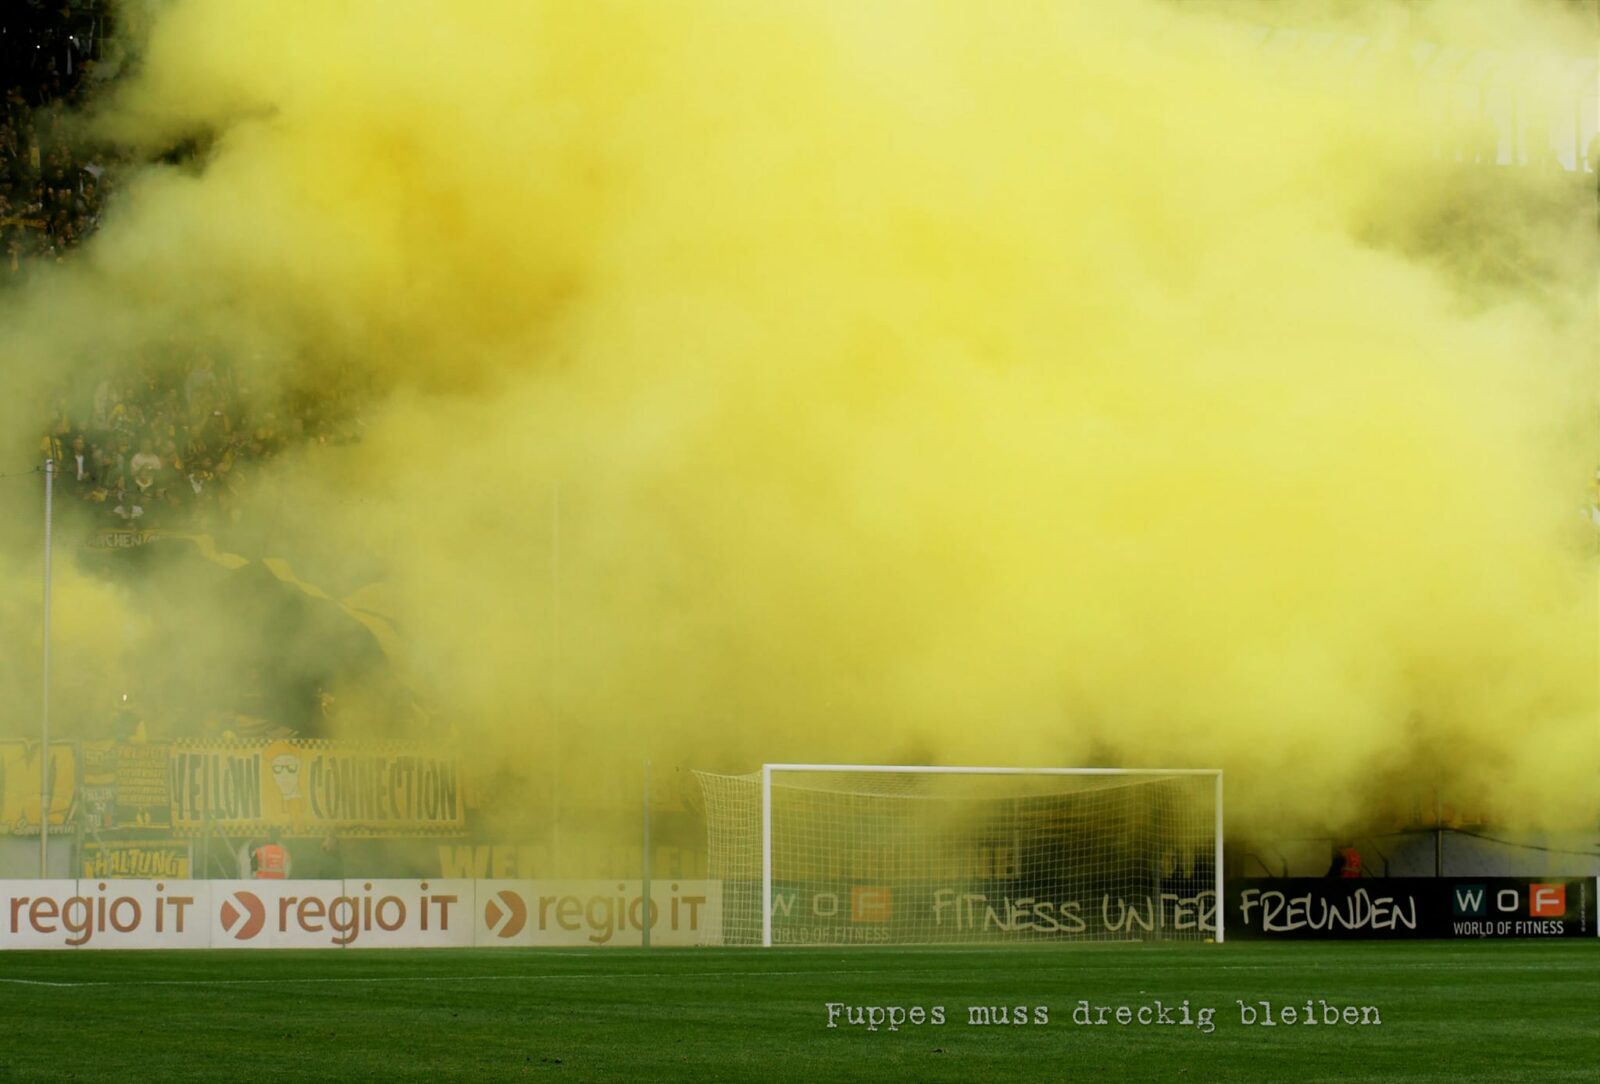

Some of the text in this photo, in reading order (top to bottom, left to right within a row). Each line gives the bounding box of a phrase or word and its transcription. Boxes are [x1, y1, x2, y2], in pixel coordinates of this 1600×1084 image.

[172, 753, 261, 821] YELLOW
[309, 754, 458, 821] CONNECTION
[95, 849, 177, 876] HALTUNG
[9, 883, 142, 945] regio
[278, 883, 407, 945] regio
[538, 882, 658, 944] regio
[771, 925, 891, 943] ORLD OF FITNESS
[932, 887, 1417, 933] FITNESS UNTER FREUNDEN
[1453, 920, 1564, 935] WORLD OF FITNESS
